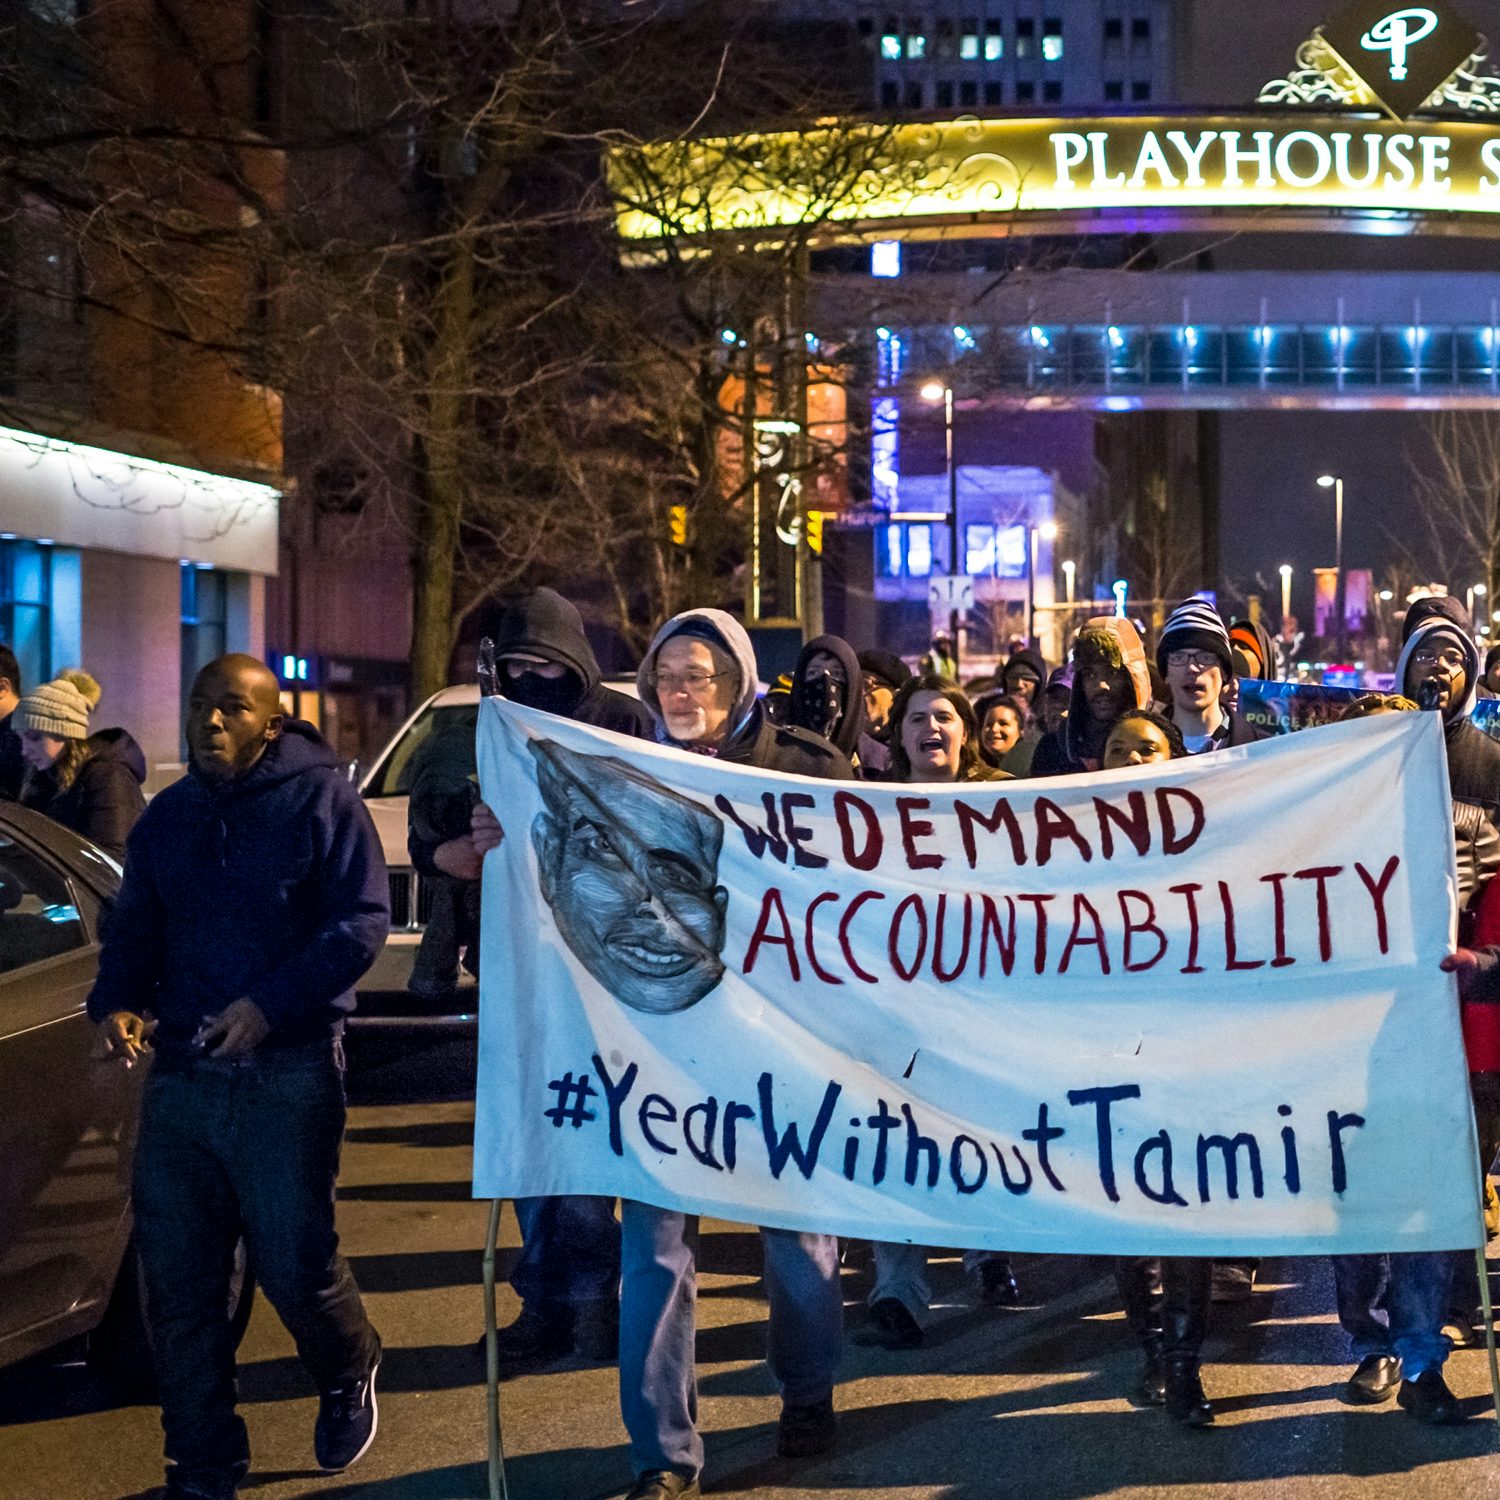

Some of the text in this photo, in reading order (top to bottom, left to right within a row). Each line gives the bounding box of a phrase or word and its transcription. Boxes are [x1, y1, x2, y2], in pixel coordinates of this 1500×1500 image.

[1048, 130, 1453, 192] PLAYHOUSE
[1246, 713, 1301, 729] POLICE
[742, 855, 1401, 985] ACCOUNTABILITY
